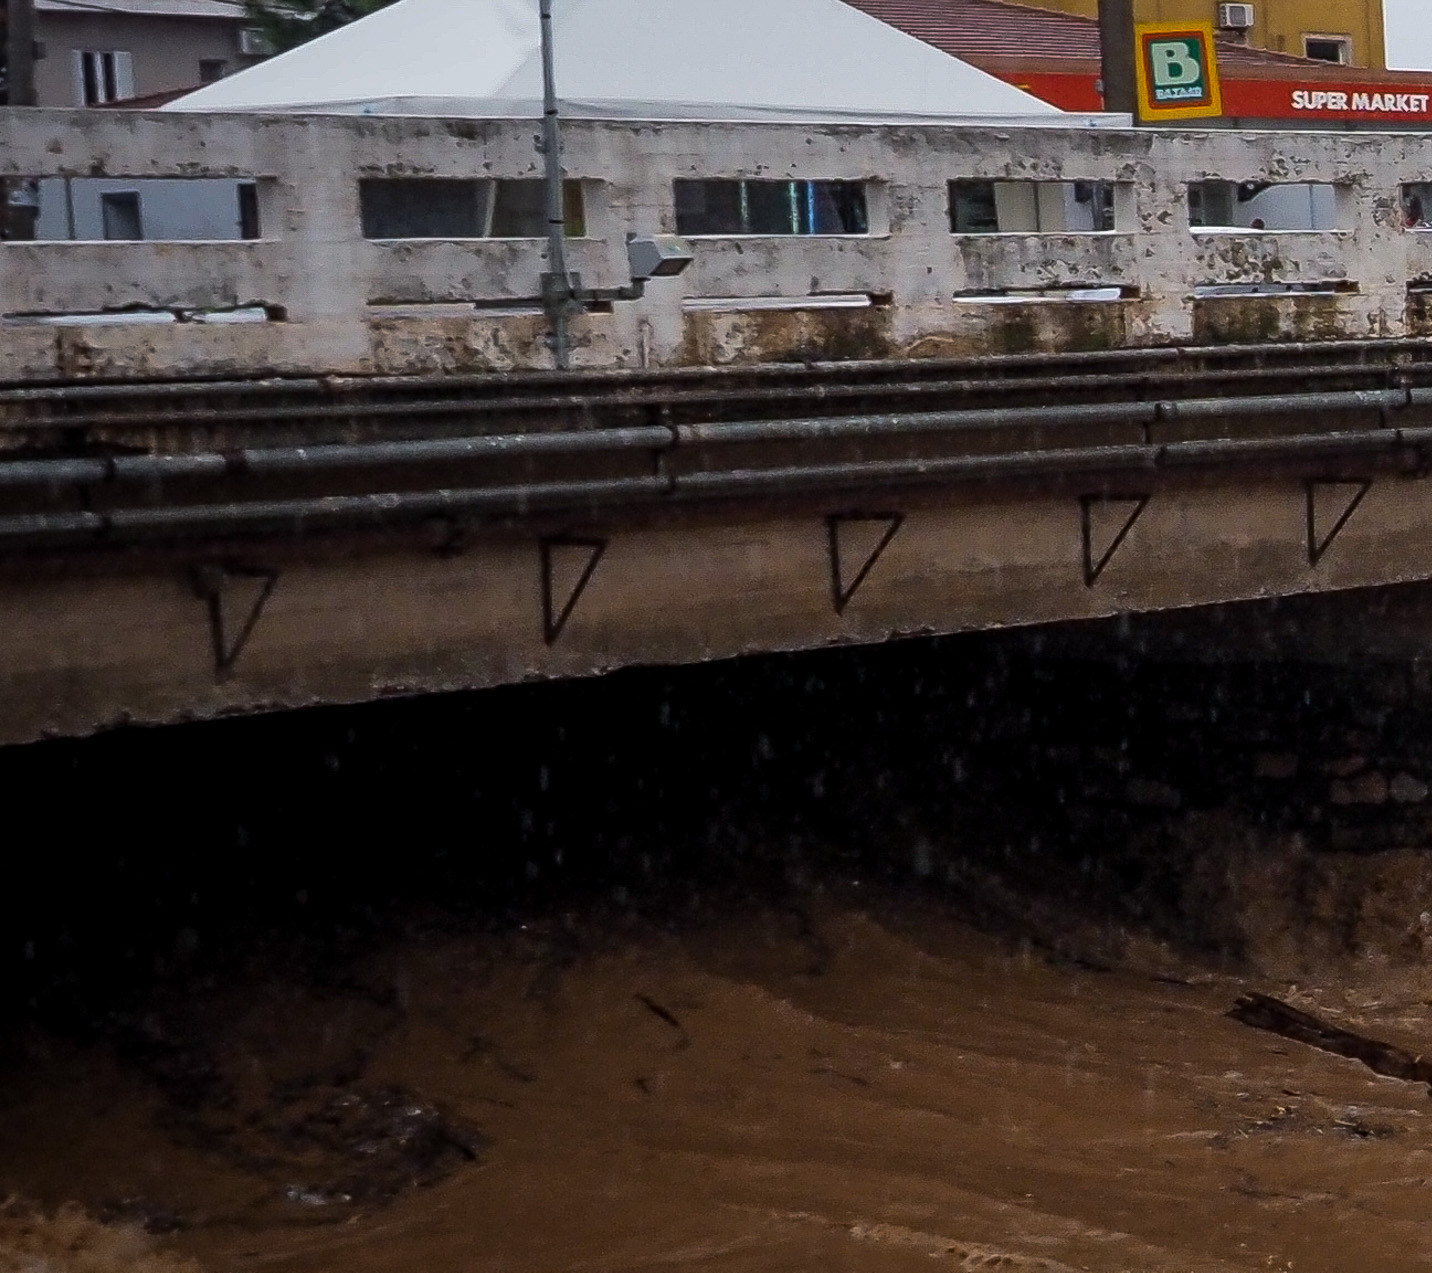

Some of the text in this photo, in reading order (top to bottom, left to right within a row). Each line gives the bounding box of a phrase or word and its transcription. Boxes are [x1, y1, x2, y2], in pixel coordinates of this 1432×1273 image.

[1151, 41, 1199, 86] B
[1291, 90, 1429, 112] SUPER MARKET
